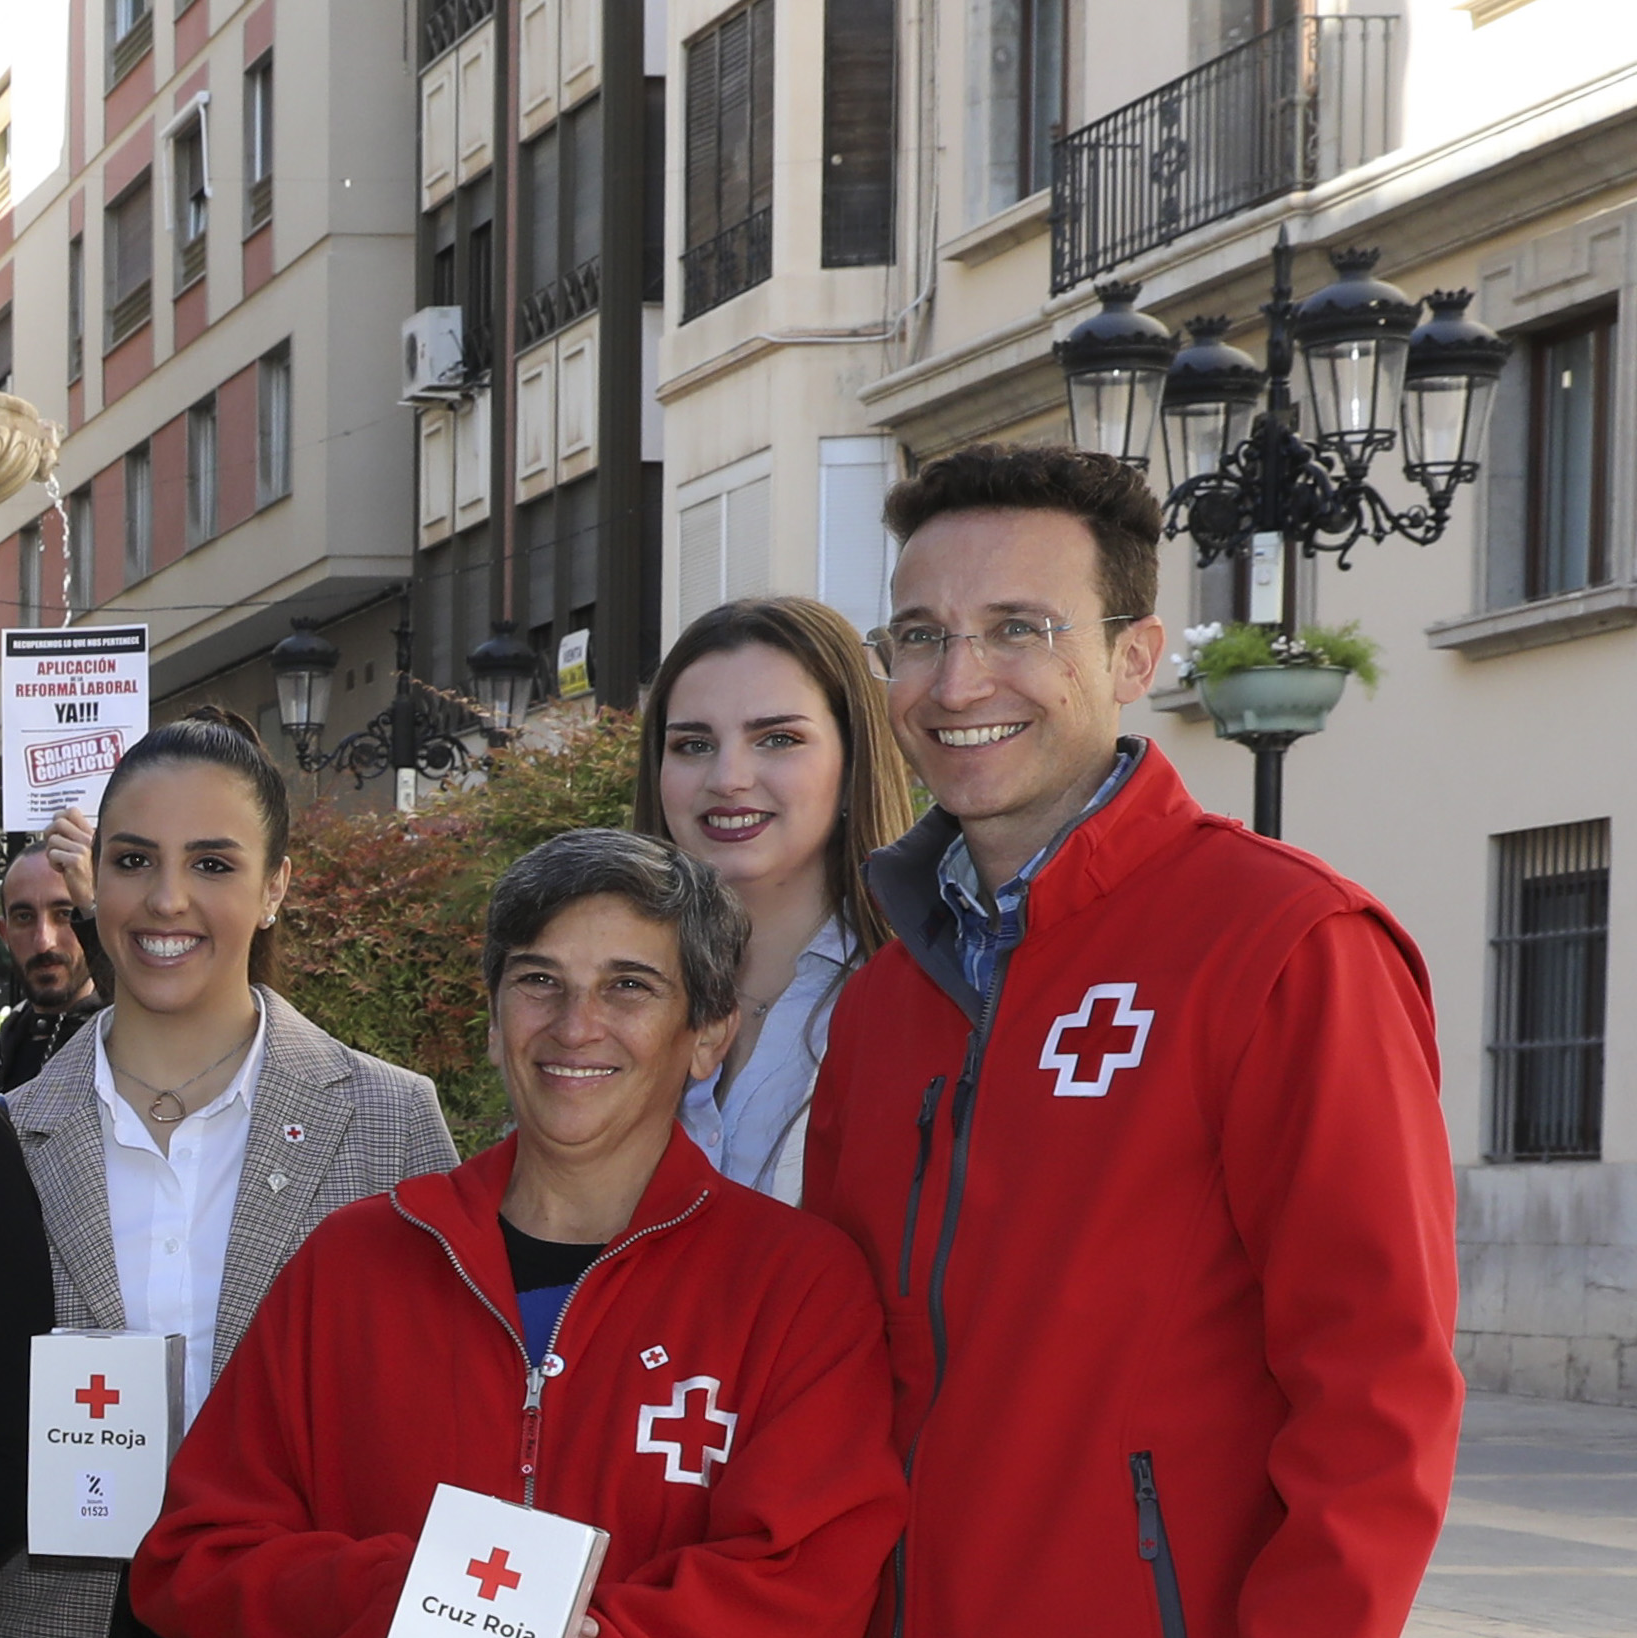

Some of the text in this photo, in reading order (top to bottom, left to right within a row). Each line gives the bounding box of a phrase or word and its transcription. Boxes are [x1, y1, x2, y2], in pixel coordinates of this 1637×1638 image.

[37, 657, 116, 676] APLICACIÓN
[15, 679, 139, 697] REFORMA LABORAL
[54, 702, 99, 724] YA!!!
[33, 739, 97, 766] SALARIO
[47, 1428, 146, 1449] Cruz Roja
[81, 1506, 109, 1517] 01523
[421, 1595, 476, 1627] Cruz
